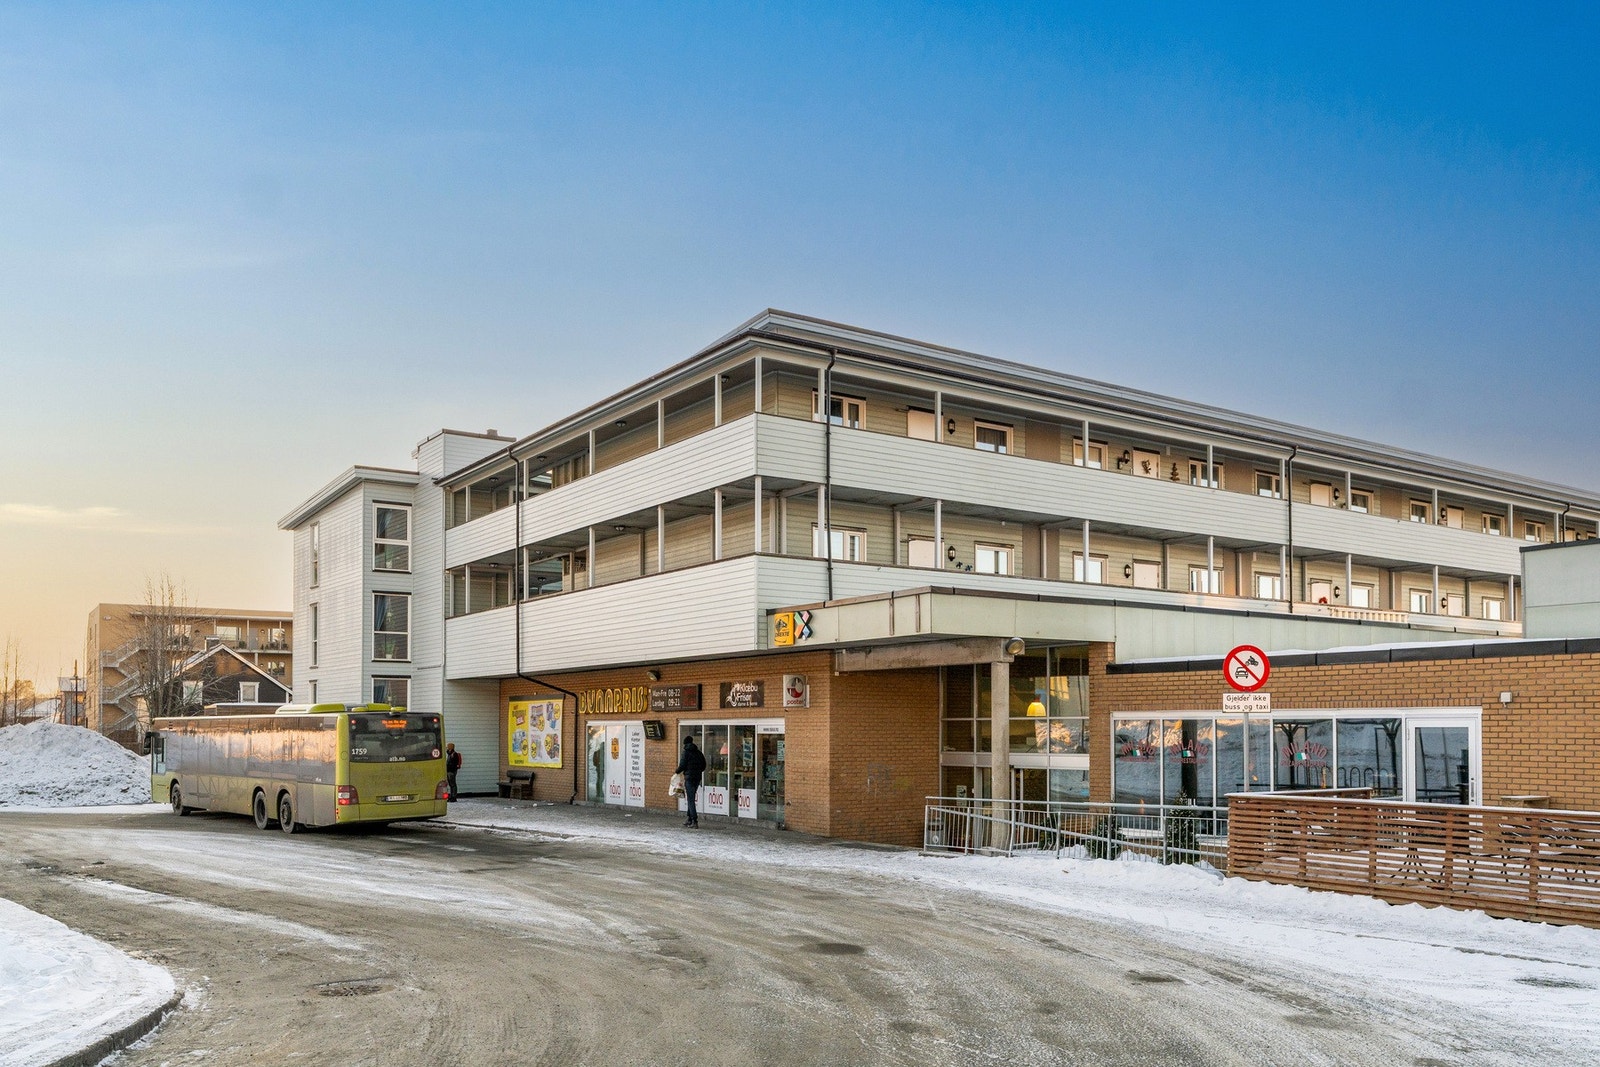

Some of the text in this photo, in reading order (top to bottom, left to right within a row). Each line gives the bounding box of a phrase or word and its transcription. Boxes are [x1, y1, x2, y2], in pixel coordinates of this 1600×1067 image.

[667, 688, 681, 697] 08-22
[667, 698, 681, 707] 09-21
[1226, 694, 1267, 703] Gjelder ikke
[1224, 703, 1241, 711] buss
[1243, 704, 1253, 712] og
[1281, 740, 1328, 760] MILANO
